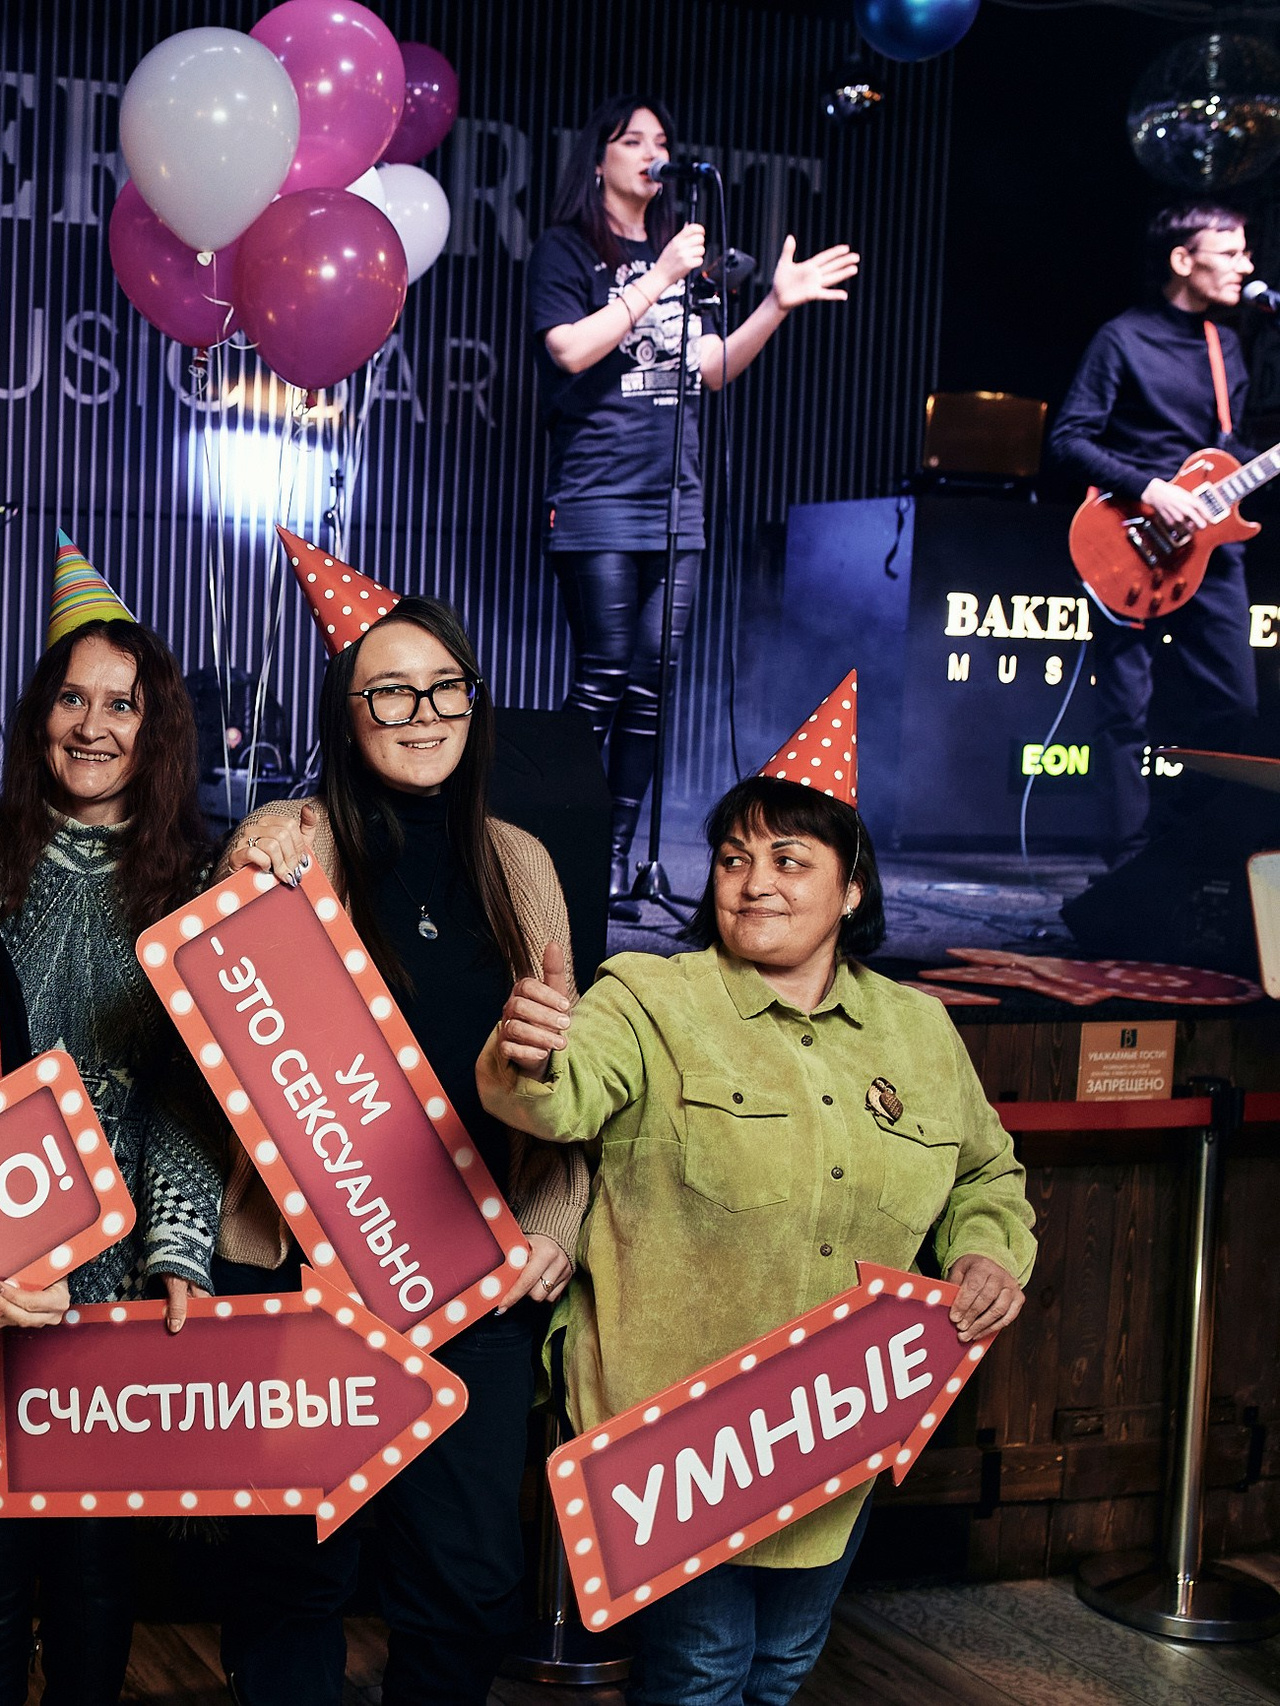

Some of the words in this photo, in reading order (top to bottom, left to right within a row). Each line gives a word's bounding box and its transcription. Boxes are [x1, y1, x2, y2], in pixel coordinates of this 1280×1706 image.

[335, 1053, 391, 1125] УМ
[1086, 1078, 1164, 1093] ЗАПРЕЩЕНО
[218, 957, 285, 1046] ЭТО
[271, 1049, 434, 1313] СЕКСУАЛЬНО
[18, 1376, 380, 1435] СЧАСТЛИВЫЕ
[611, 1323, 933, 1546] УМНЫЕ
